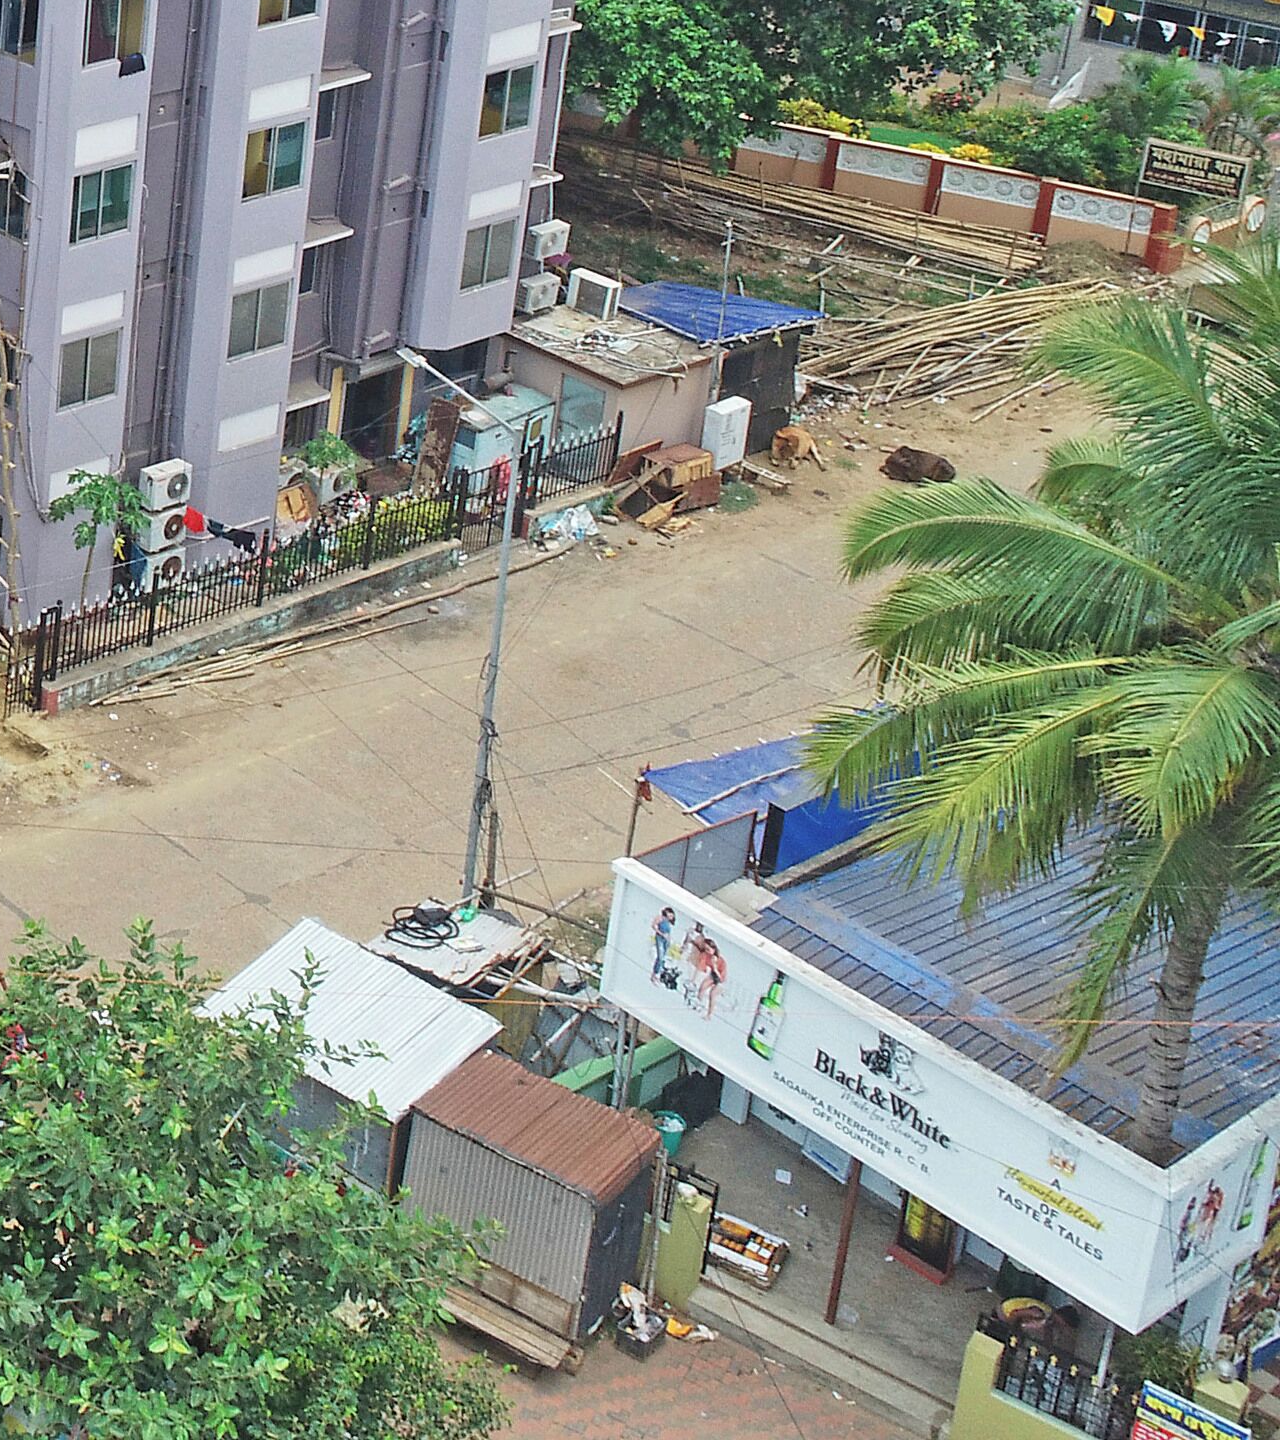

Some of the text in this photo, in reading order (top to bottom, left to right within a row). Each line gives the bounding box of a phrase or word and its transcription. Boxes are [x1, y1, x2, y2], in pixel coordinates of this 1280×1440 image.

[773, 1070, 825, 1109] SAGARIKA
[826, 1104, 891, 1150] ENTERPRISE
[812, 1107, 886, 1156] OFF COUNTER
[1050, 1178, 1061, 1192] A
[997, 1186, 1103, 1261] TASTE & TALES
[1040, 1203, 1060, 1219] OF
